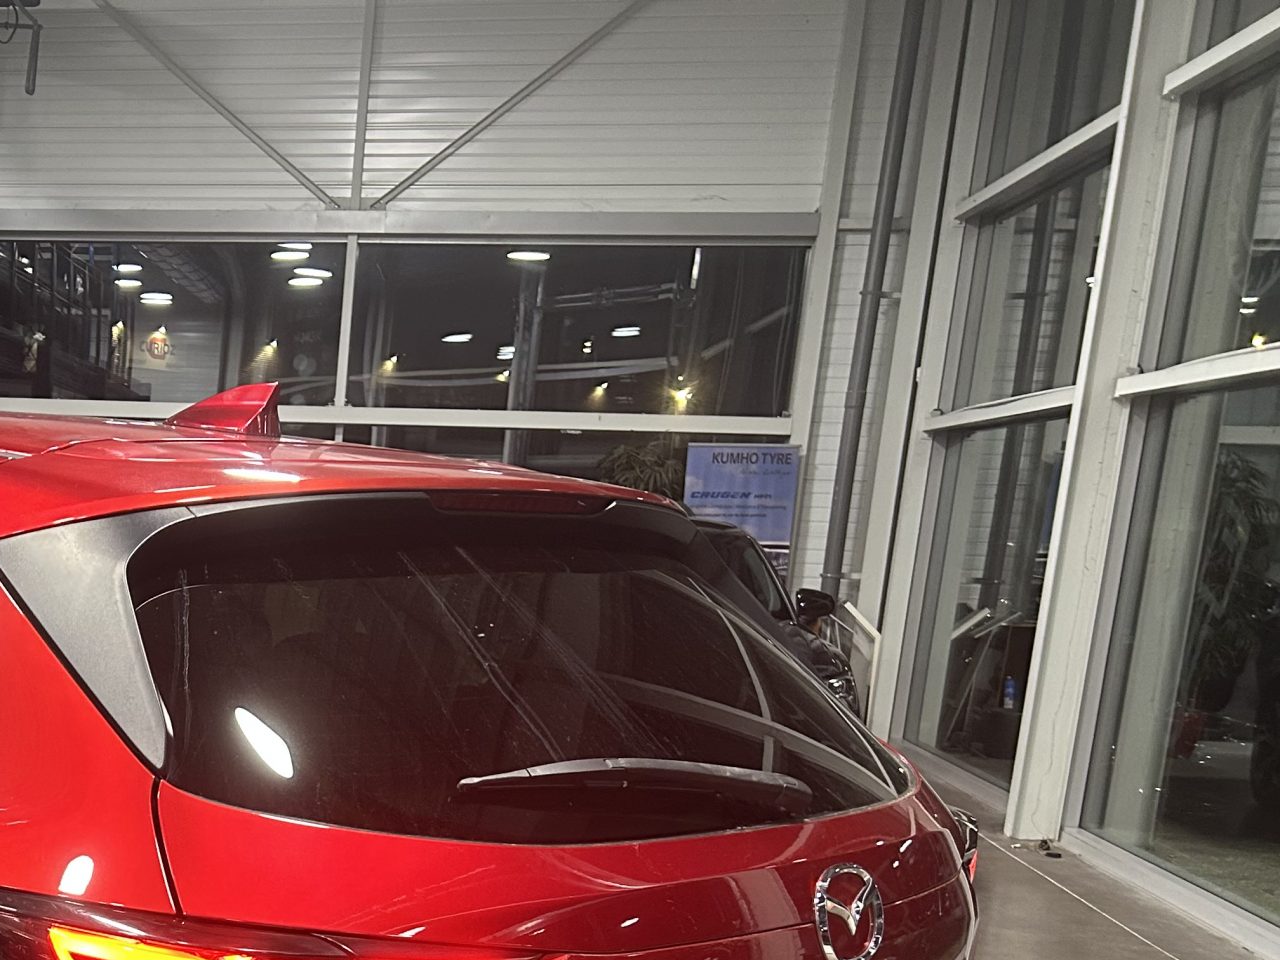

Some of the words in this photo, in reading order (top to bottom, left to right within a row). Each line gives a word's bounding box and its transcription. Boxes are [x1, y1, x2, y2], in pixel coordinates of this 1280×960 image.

[711, 452, 759, 465] KUMHO
[761, 453, 792, 465] TYRE
[690, 491, 752, 499] CRUGEN
